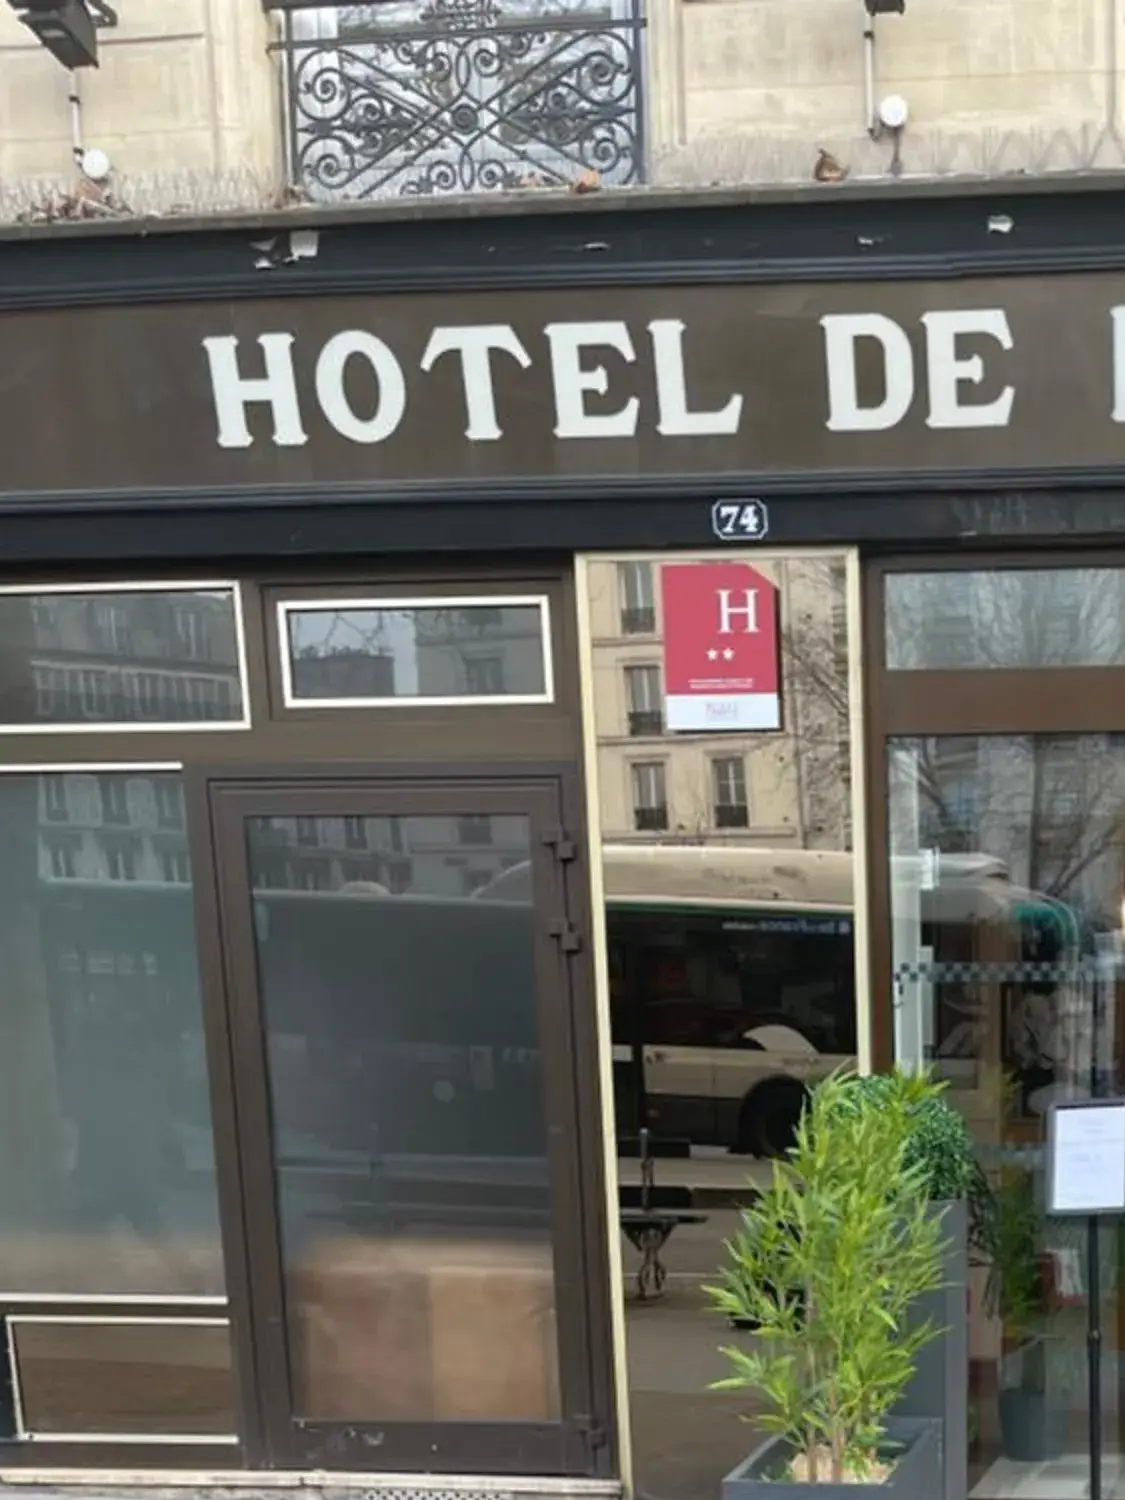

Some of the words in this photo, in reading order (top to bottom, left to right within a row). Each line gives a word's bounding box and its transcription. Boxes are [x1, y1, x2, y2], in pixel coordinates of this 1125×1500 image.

[203, 320, 742, 447] HOTEL
[820, 309, 1014, 430] DE
[720, 505, 758, 533] 74
[717, 588, 760, 634] H
